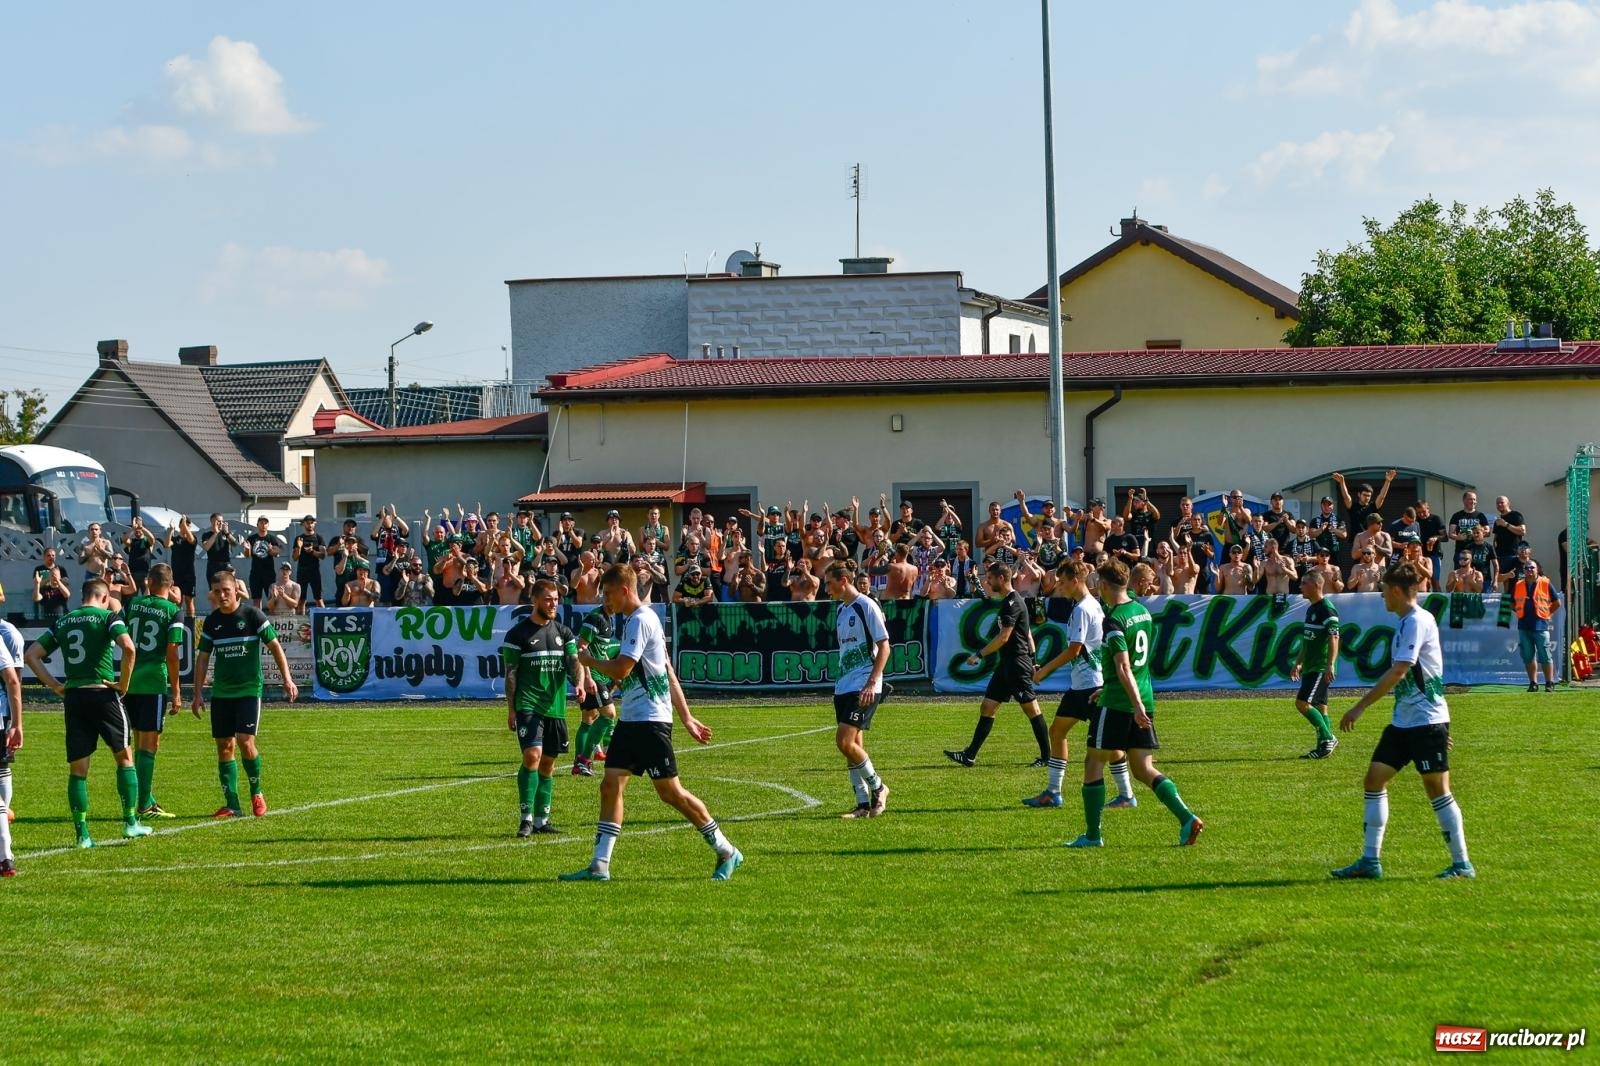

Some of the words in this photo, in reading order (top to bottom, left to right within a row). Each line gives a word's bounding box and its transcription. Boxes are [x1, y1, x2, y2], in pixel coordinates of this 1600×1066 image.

[129, 617, 159, 652] 13
[395, 606, 497, 642] ROW
[67, 629, 86, 665] 3
[1134, 630, 1149, 667] 9
[373, 645, 464, 688] nigdy
[678, 650, 763, 684] ROW
[850, 711, 860, 721] 15
[649, 767, 661, 778] 14
